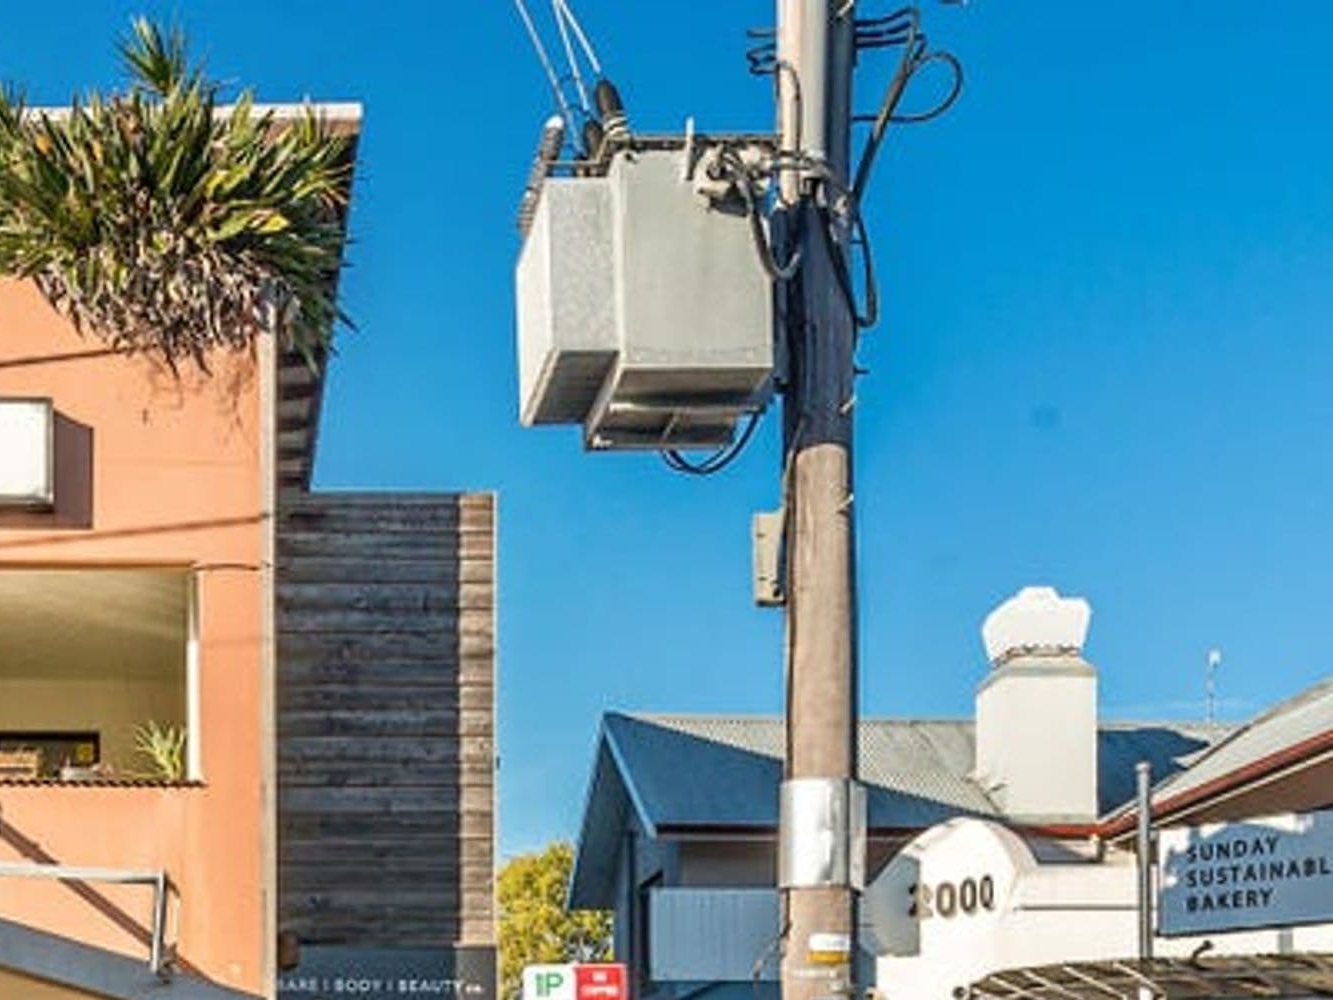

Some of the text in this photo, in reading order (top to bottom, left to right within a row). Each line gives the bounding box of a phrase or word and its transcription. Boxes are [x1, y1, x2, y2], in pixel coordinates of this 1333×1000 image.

[1186, 836, 1278, 863] SUNDAY
[1186, 857, 1331, 888] SUSTAINABL
[908, 875, 995, 919] 2000
[1186, 888, 1274, 913] BAKERY
[334, 978, 381, 992] BODY
[398, 978, 464, 993] BEAUTY
